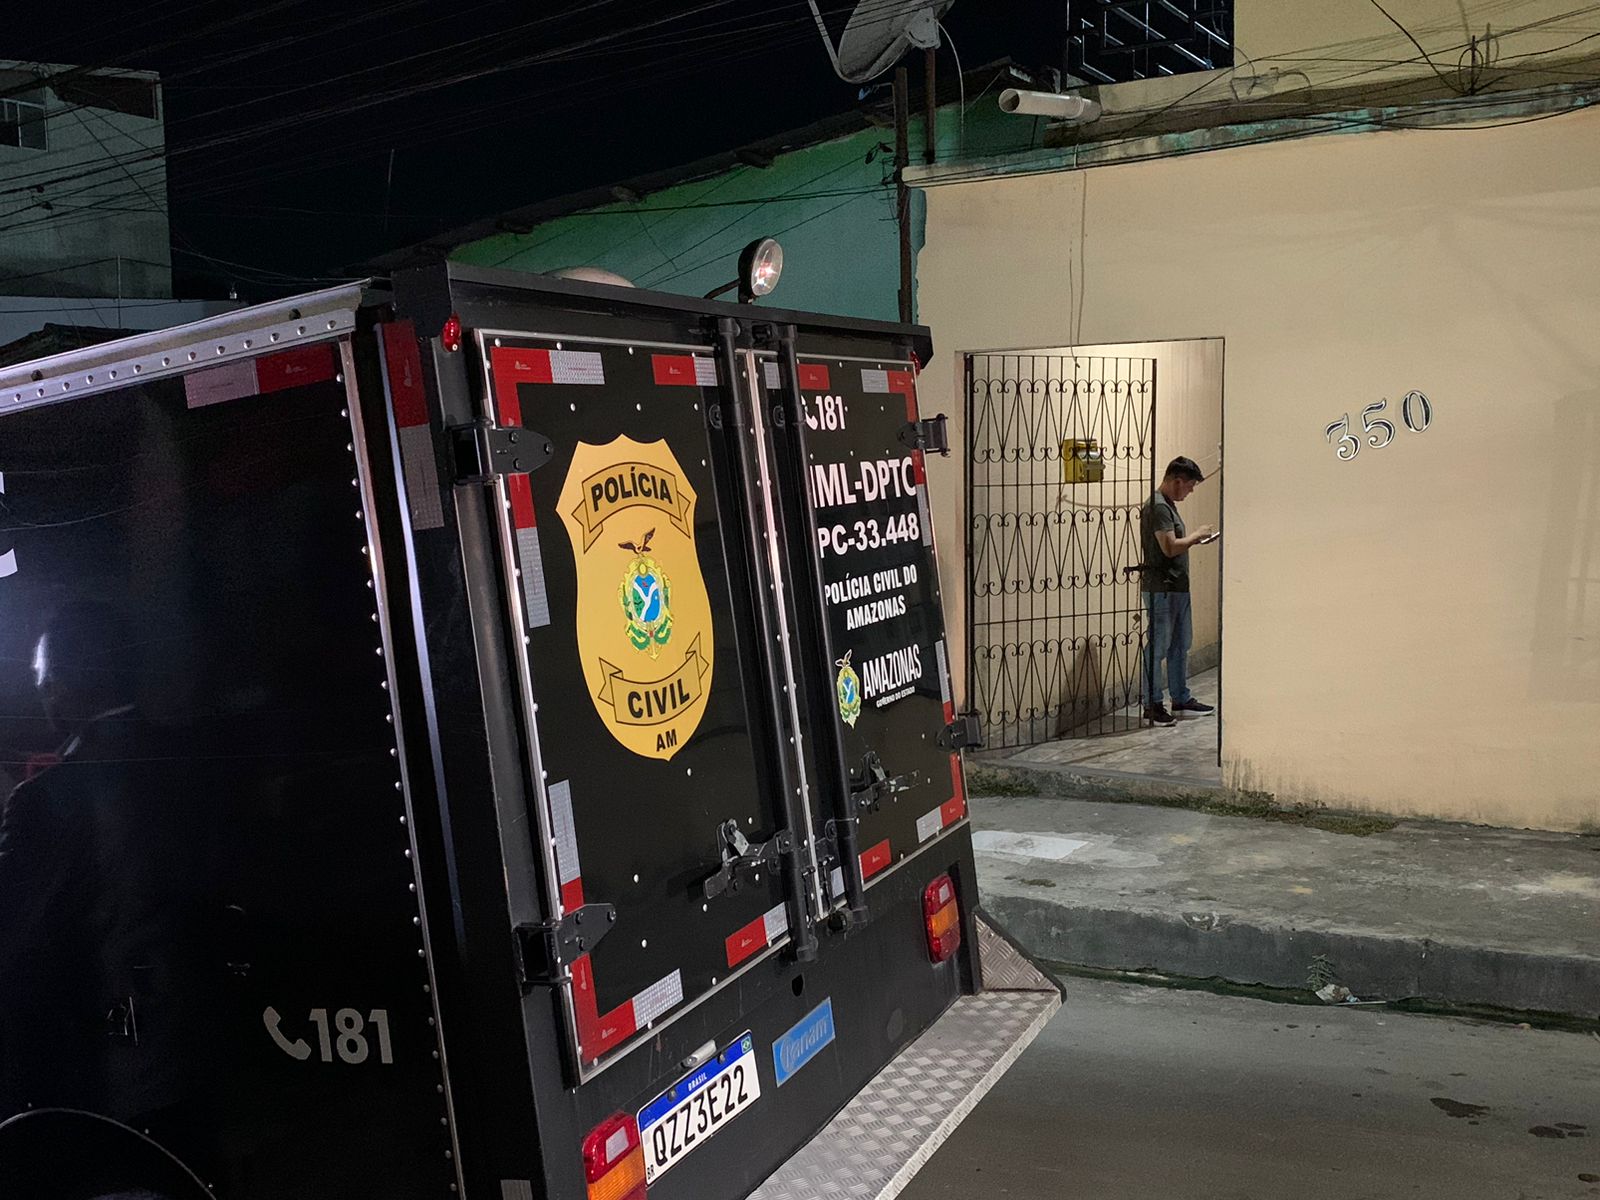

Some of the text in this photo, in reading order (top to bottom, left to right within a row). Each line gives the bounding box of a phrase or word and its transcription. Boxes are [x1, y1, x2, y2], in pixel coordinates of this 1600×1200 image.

[815, 395, 846, 431] 181
[1325, 389, 1432, 461] 350
[591, 466, 673, 513] POLÍCIA
[817, 512, 920, 559] PC-33.448
[824, 564, 918, 606] POLÍCIA CIVIL DO
[847, 594, 906, 631] AMAZONAS
[862, 644, 922, 699] AMAZONAS
[627, 678, 690, 719] CIVIL
[656, 729, 678, 752] AM
[309, 1008, 393, 1064] 181
[687, 1072, 708, 1092] BRASIL
[652, 1064, 749, 1167] QZZ3E22
